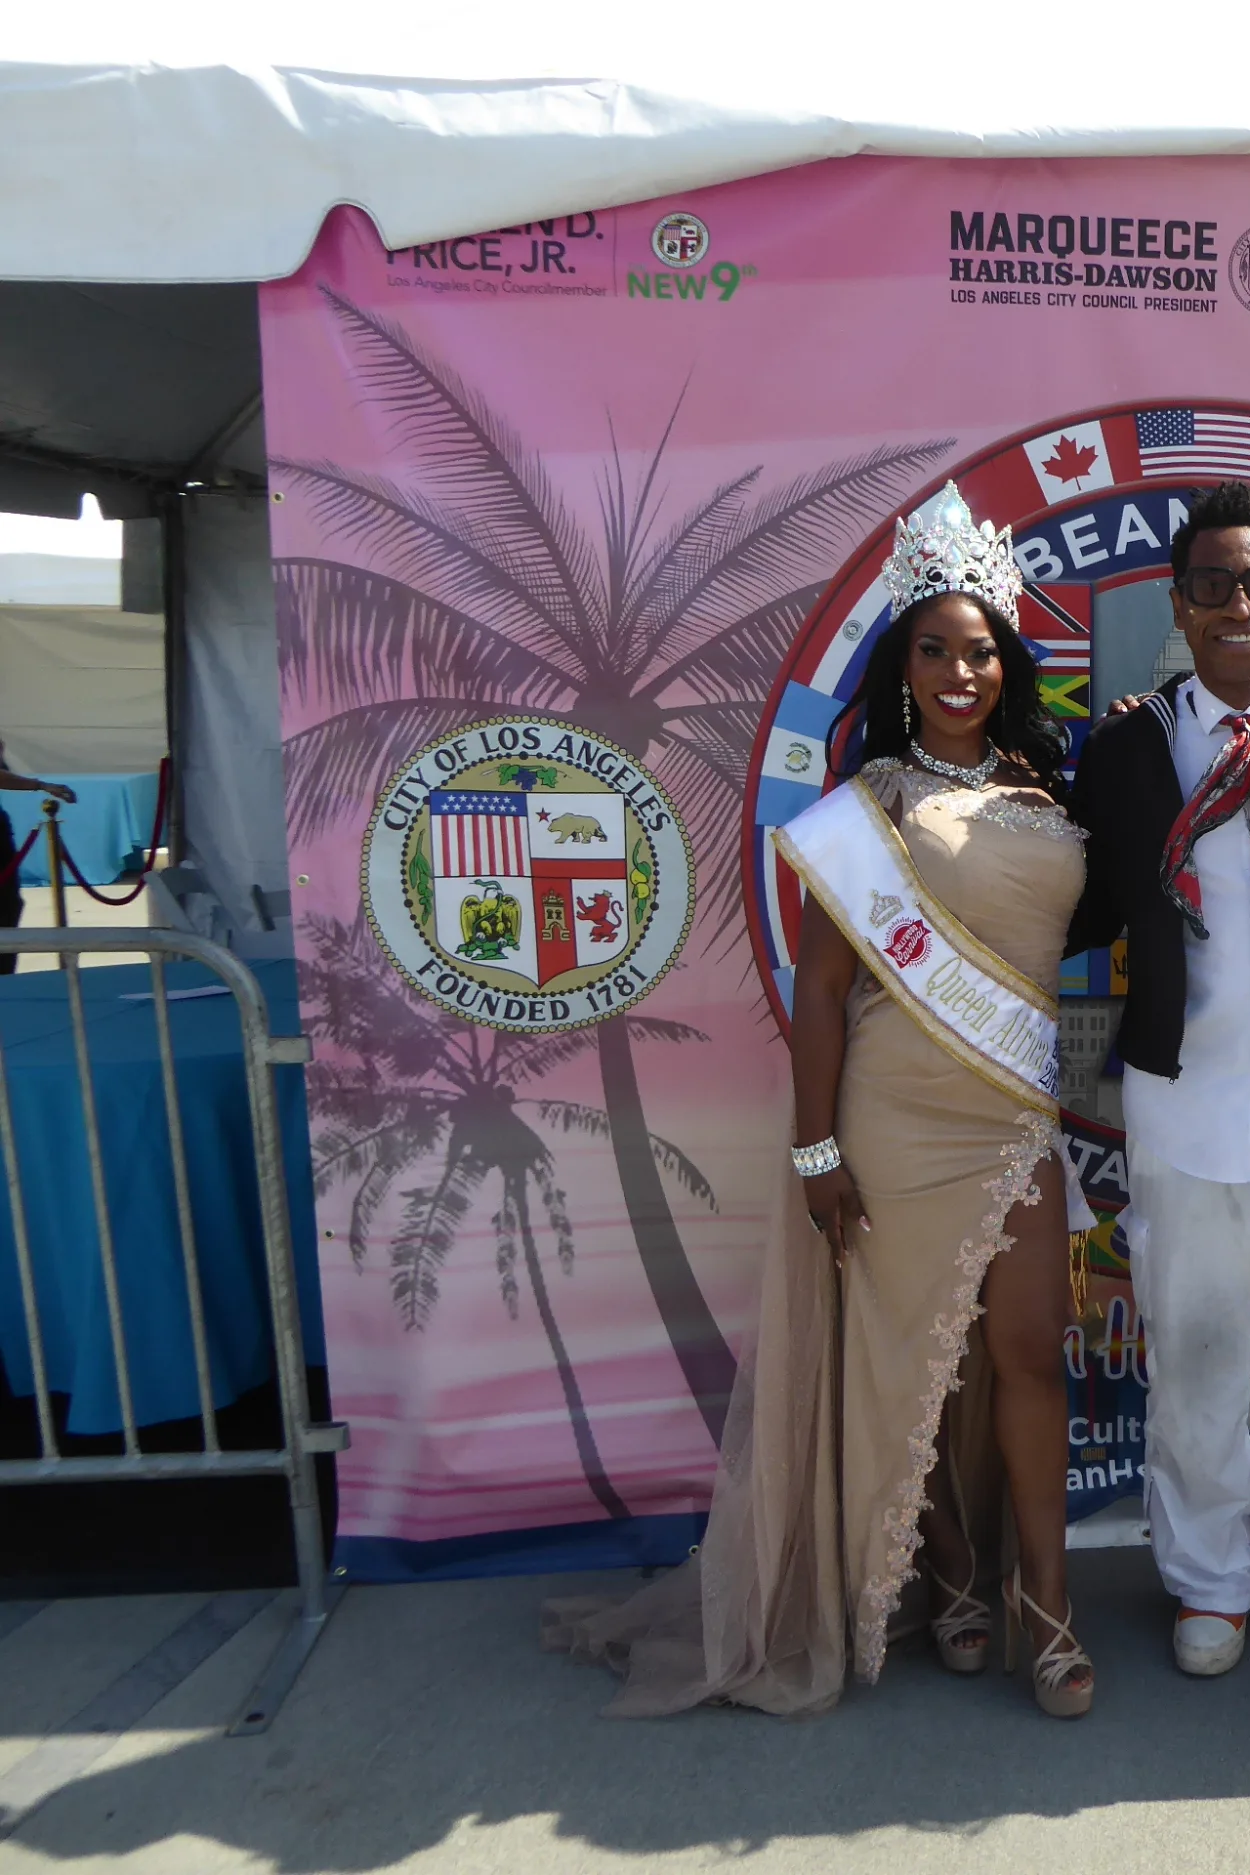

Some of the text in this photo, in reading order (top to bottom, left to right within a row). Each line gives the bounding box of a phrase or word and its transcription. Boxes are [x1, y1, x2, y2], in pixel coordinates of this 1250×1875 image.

[950, 210, 1218, 261] MARQUEECE
[519, 240, 576, 274] JR.
[949, 257, 1218, 292] HARRIS-DAWSON
[387, 274, 608, 297] Los Angeles City Councilmember
[628, 272, 708, 301] NEW
[951, 289, 1218, 314] LOS ANGELES CITY COUNCIL PRESIDENT
[384, 726, 671, 832] CITY OF LOS ANGELES
[416, 959, 648, 1021] FOUNDED 1781
[926, 956, 998, 1032] Queen
